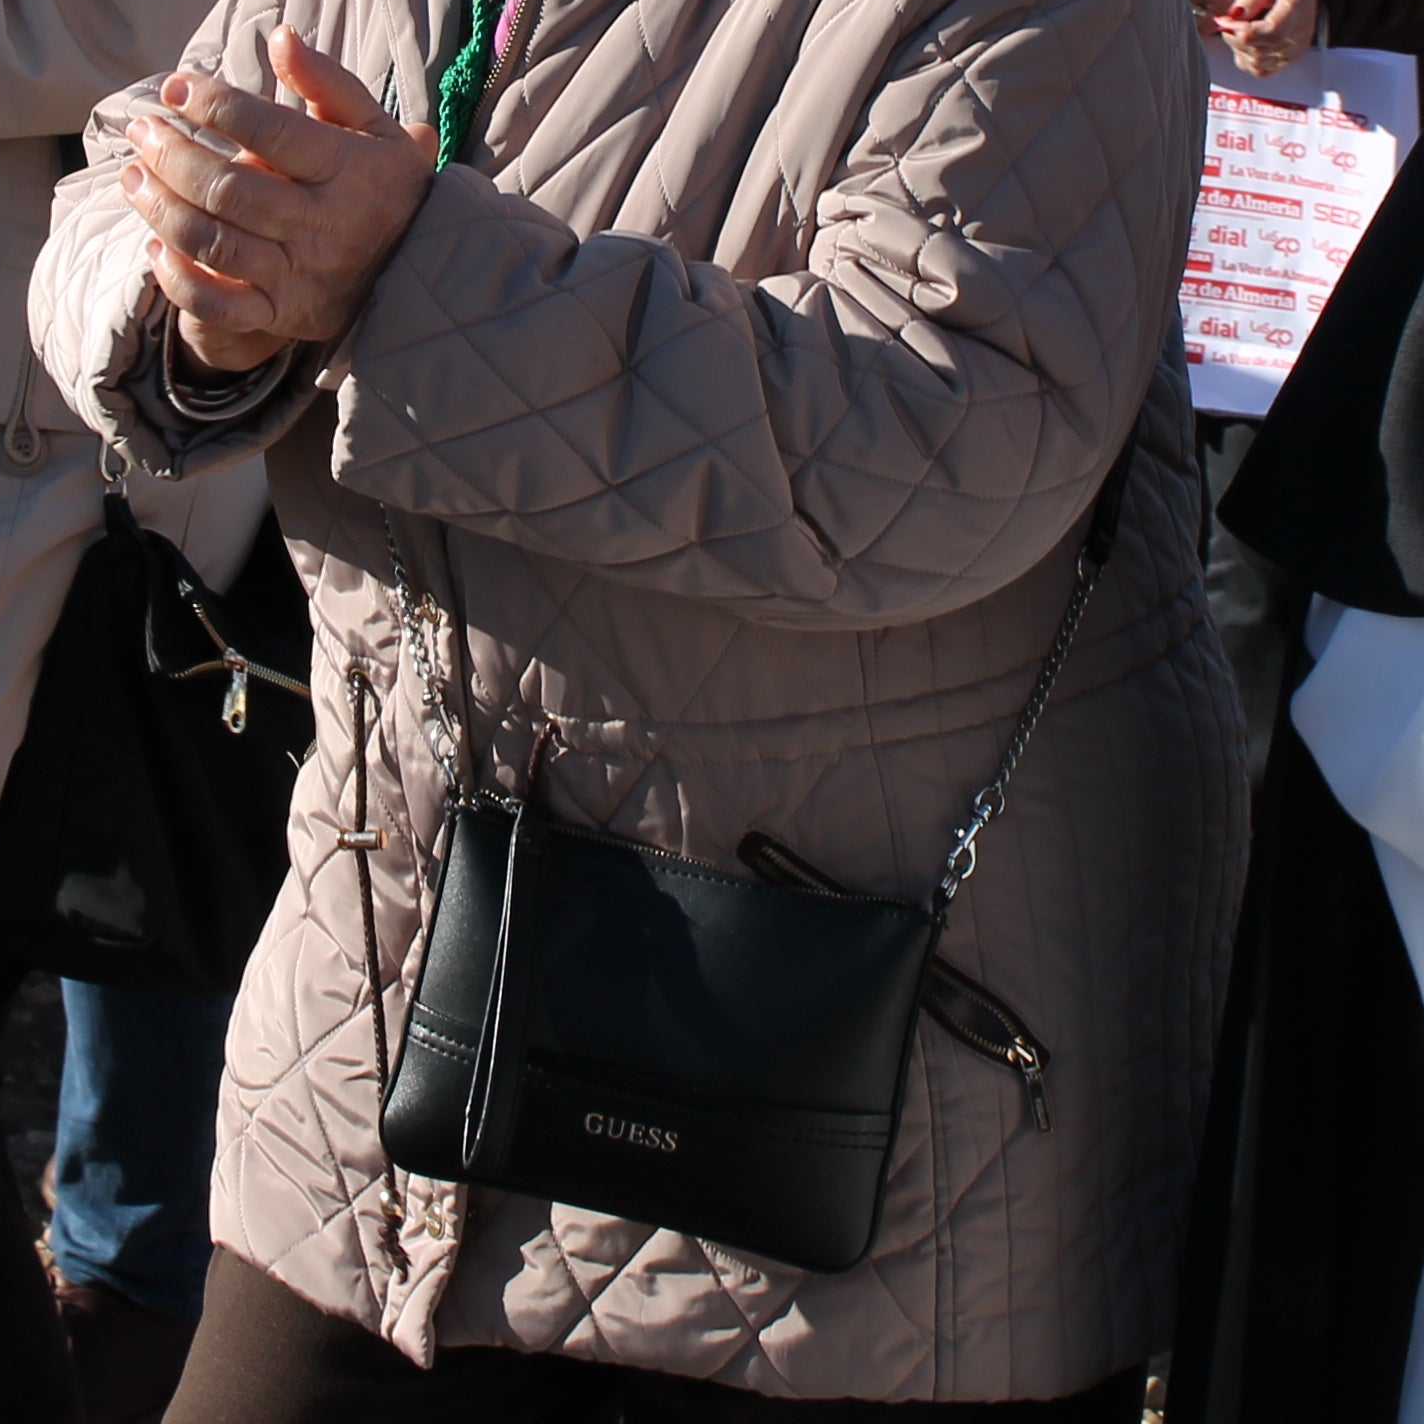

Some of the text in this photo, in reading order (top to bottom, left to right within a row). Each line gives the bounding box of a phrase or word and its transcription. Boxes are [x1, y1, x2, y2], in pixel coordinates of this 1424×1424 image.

[1216, 94, 1236, 111] de
[1216, 130, 1256, 154] dial
[1208, 190, 1230, 207] de
[1208, 225, 1248, 248] dial
[1199, 281, 1221, 299] de
[1200, 316, 1240, 340] dial
[584, 1112, 678, 1152] GUESS
